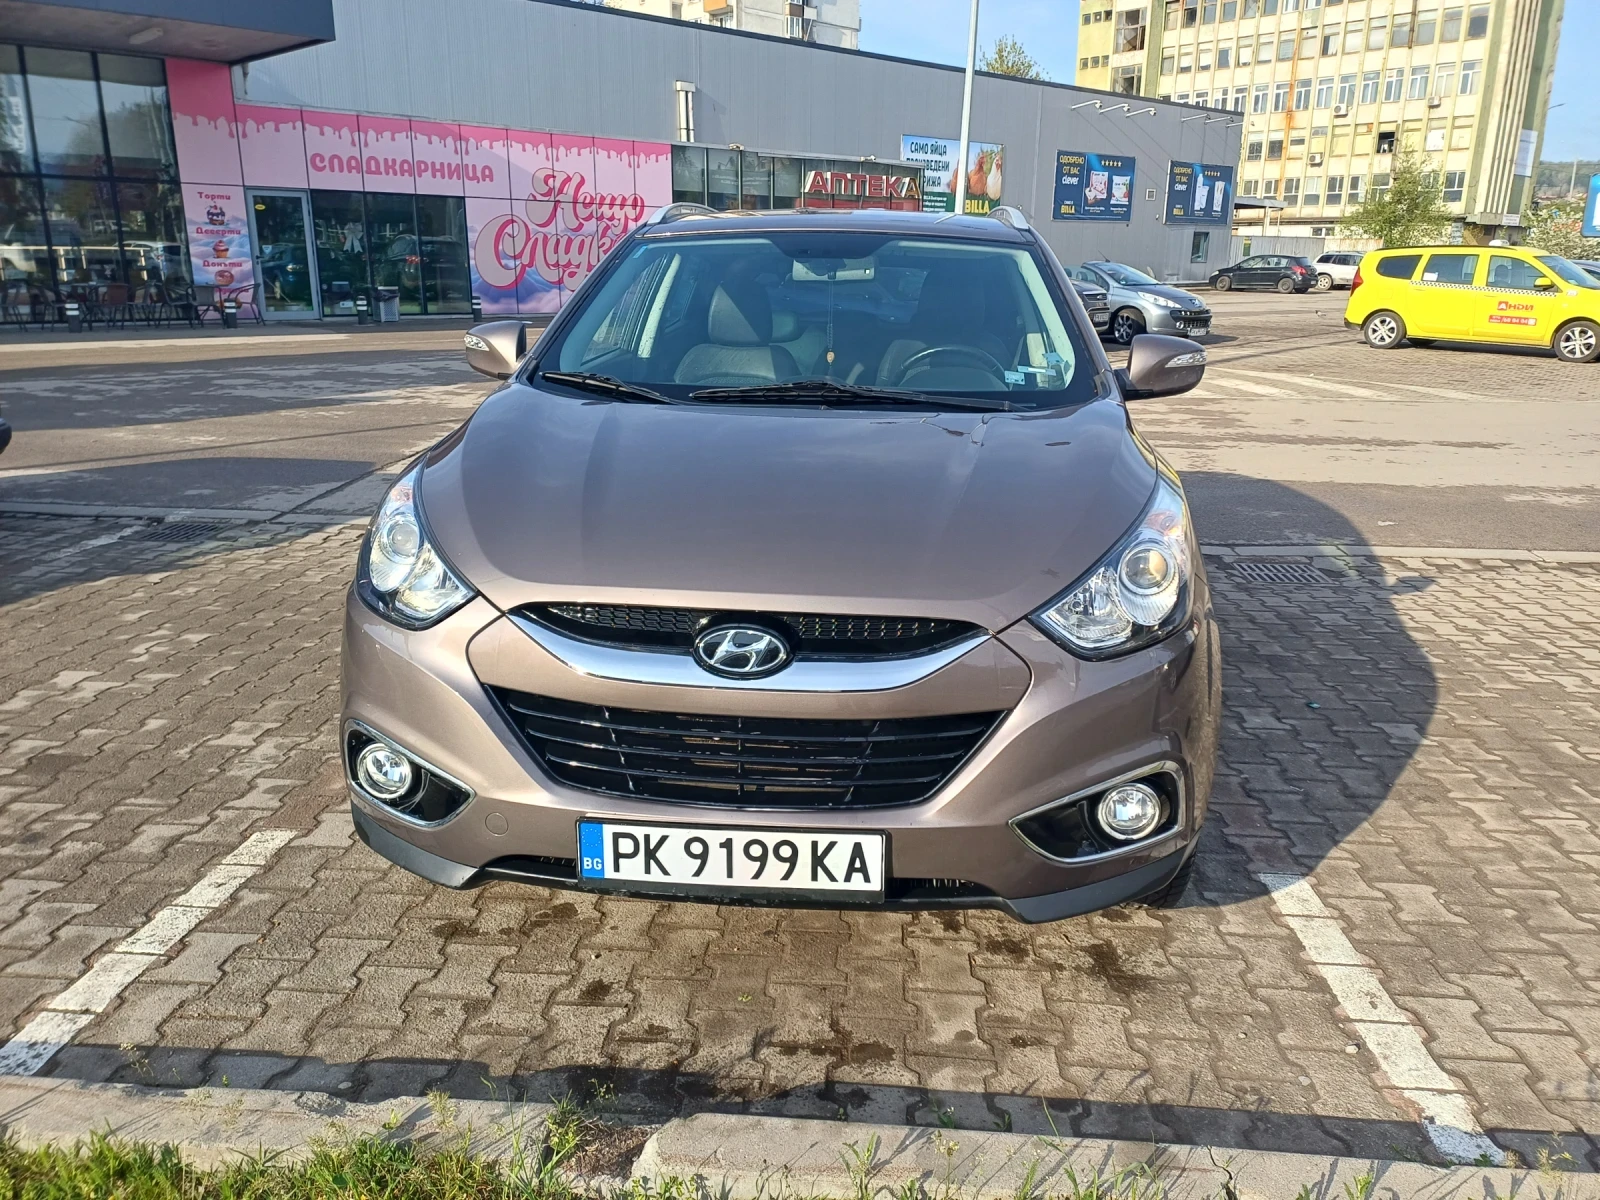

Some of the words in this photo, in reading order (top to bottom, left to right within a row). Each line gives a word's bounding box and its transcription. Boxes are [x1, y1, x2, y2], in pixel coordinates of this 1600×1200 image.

[910, 141, 929, 155] САМО
[930, 141, 948, 157] ЯЙЦА
[309, 152, 495, 184] СЛАДКАРНИЦА
[804, 171, 922, 199] АПТЕКА
[1061, 174, 1080, 185] clever
[197, 191, 231, 201] Торти
[965, 199, 990, 214] BILLA
[1060, 205, 1076, 214] BILLA
[474, 213, 623, 293] Сладк
[583, 856, 603, 870] BG
[611, 831, 672, 877] PK
[683, 836, 799, 882] 9199
[810, 840, 872, 884] KA
